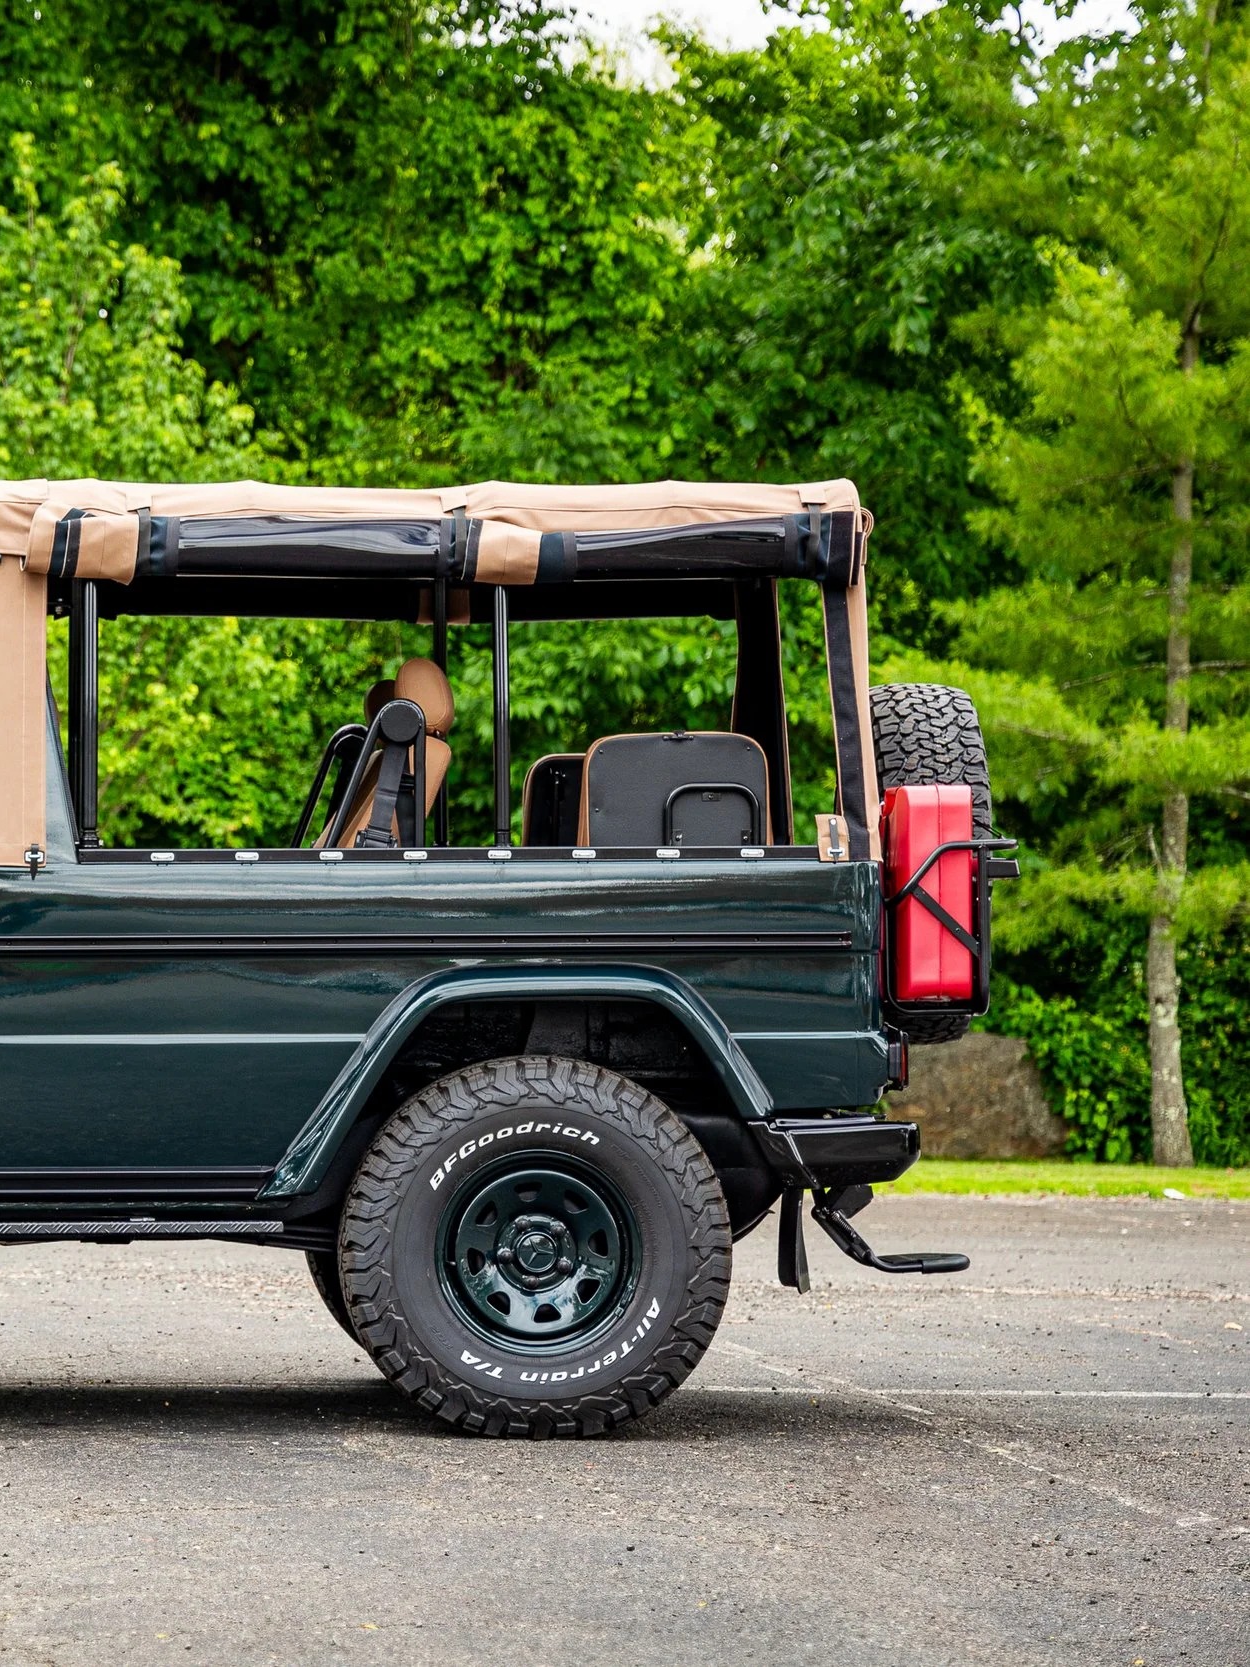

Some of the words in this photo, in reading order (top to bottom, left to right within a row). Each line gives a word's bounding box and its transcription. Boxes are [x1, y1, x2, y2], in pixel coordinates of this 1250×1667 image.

[429, 1120, 600, 1191] BFGoodrich
[460, 1349, 505, 1379] T/A
[519, 1296, 661, 1384] All-Terrain
